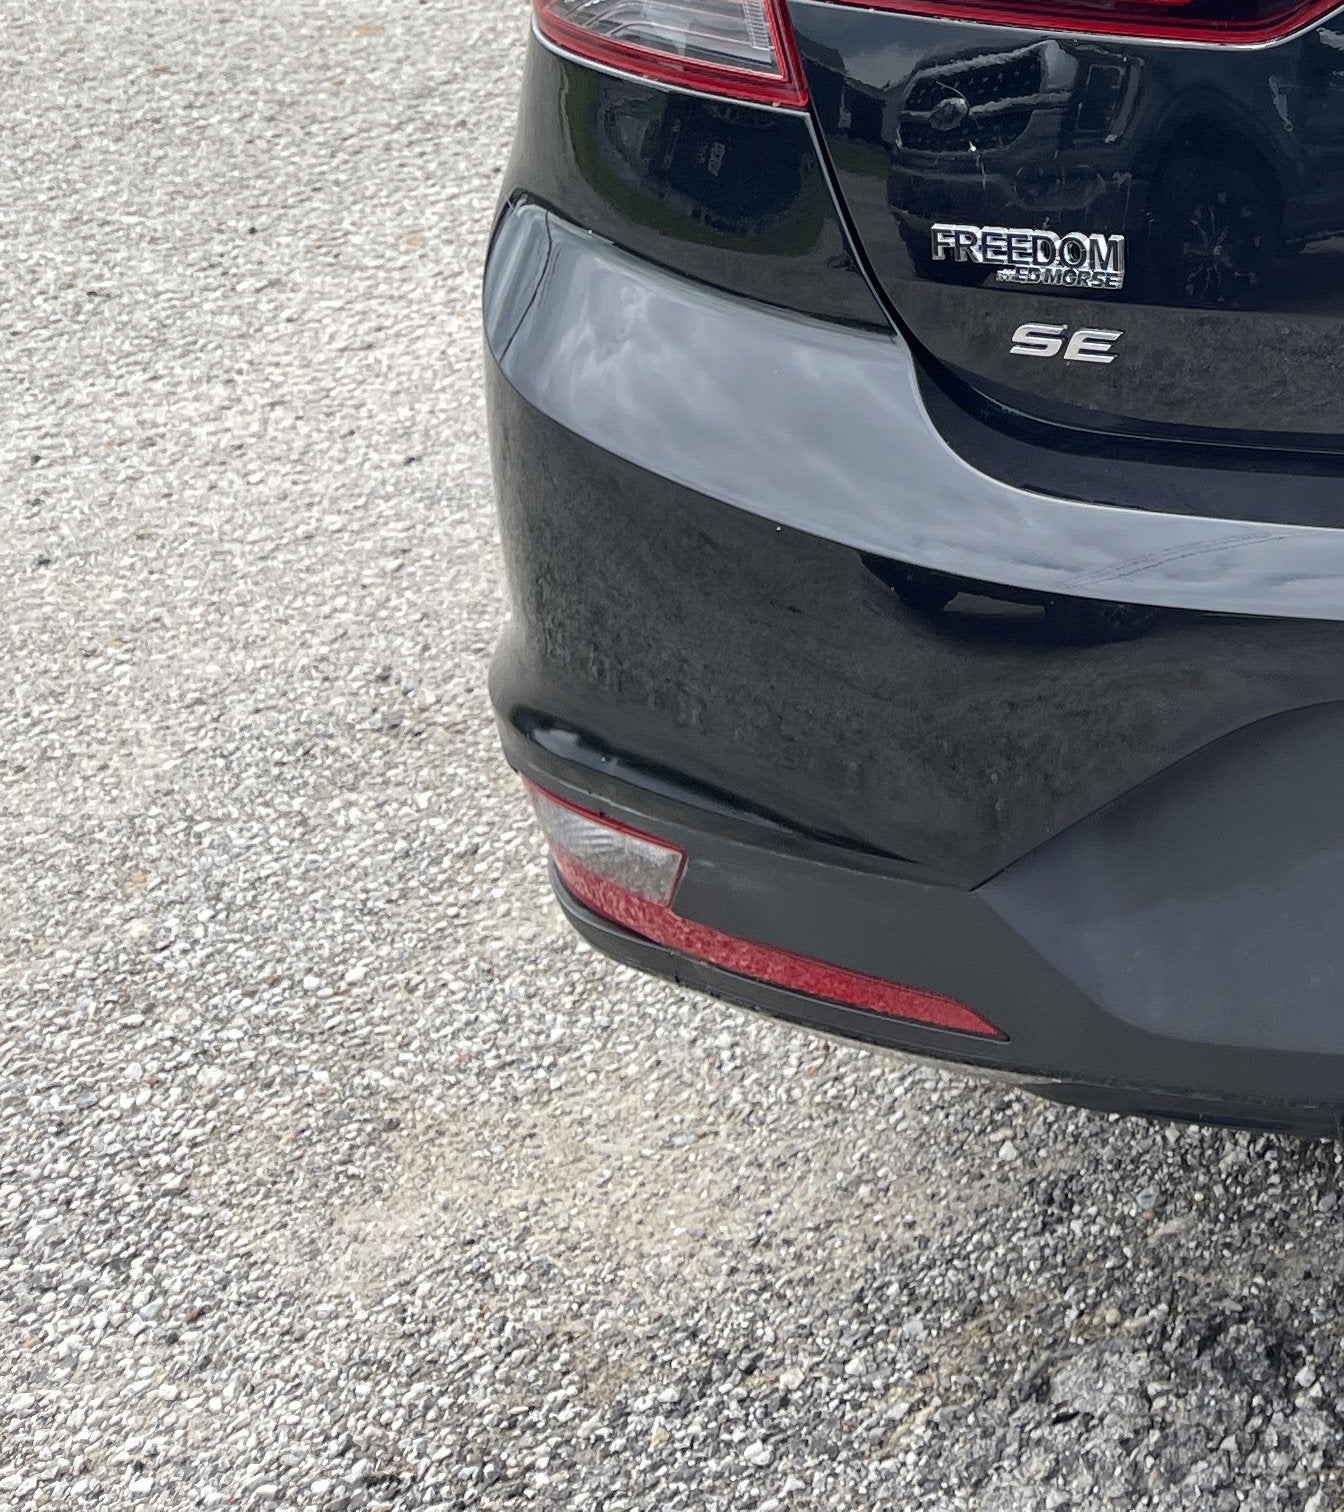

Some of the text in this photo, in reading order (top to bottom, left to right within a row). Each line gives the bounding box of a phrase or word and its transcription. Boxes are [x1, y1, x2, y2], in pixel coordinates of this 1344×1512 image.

[931, 223, 1124, 271] FREEDOM
[1014, 266, 1040, 284] ED
[1042, 267, 1122, 289] MORSE
[1010, 322, 1124, 364] SE
